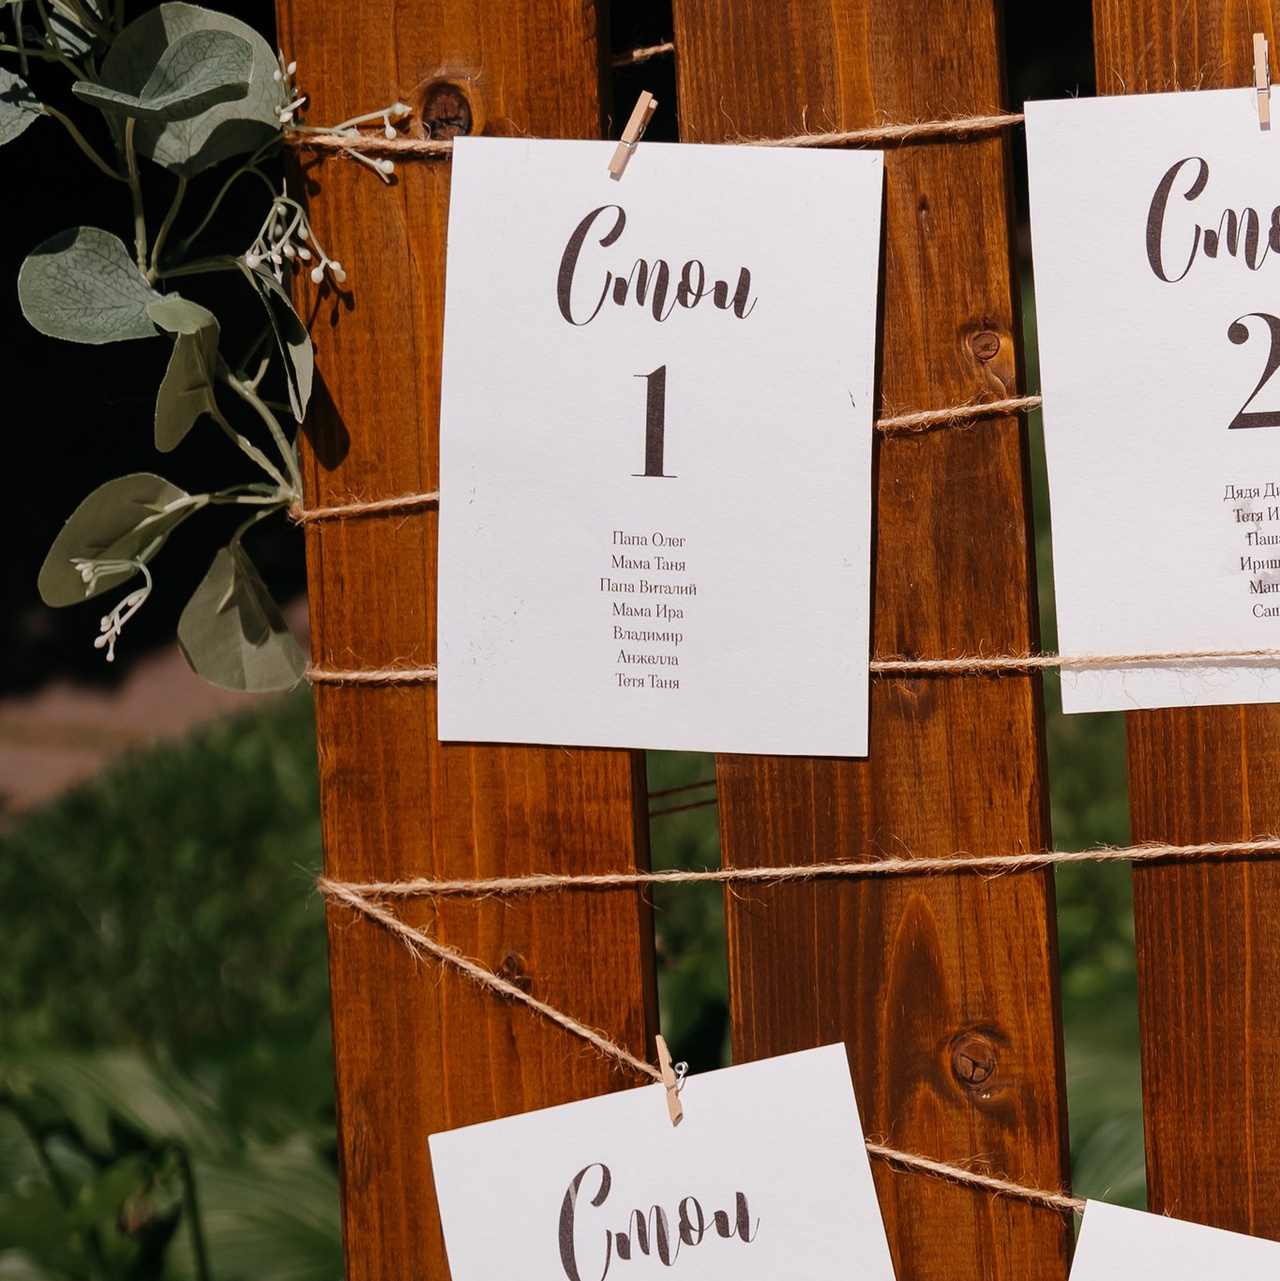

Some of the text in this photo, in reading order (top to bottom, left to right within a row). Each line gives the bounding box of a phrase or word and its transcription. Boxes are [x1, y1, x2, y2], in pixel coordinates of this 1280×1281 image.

[557, 205, 758, 326] Стол
[631, 365, 677, 478] 1
[1223, 484, 1260, 502] Дядя
[612, 530, 686, 548] Папа Олег
[611, 554, 686, 571] Мама Таня
[600, 577, 697, 596] Папа Виталий
[612, 602, 684, 622] Мама Ира
[613, 625, 684, 646] Владимир
[616, 649, 679, 666] Анжелла
[648, 674, 680, 689] Таня
